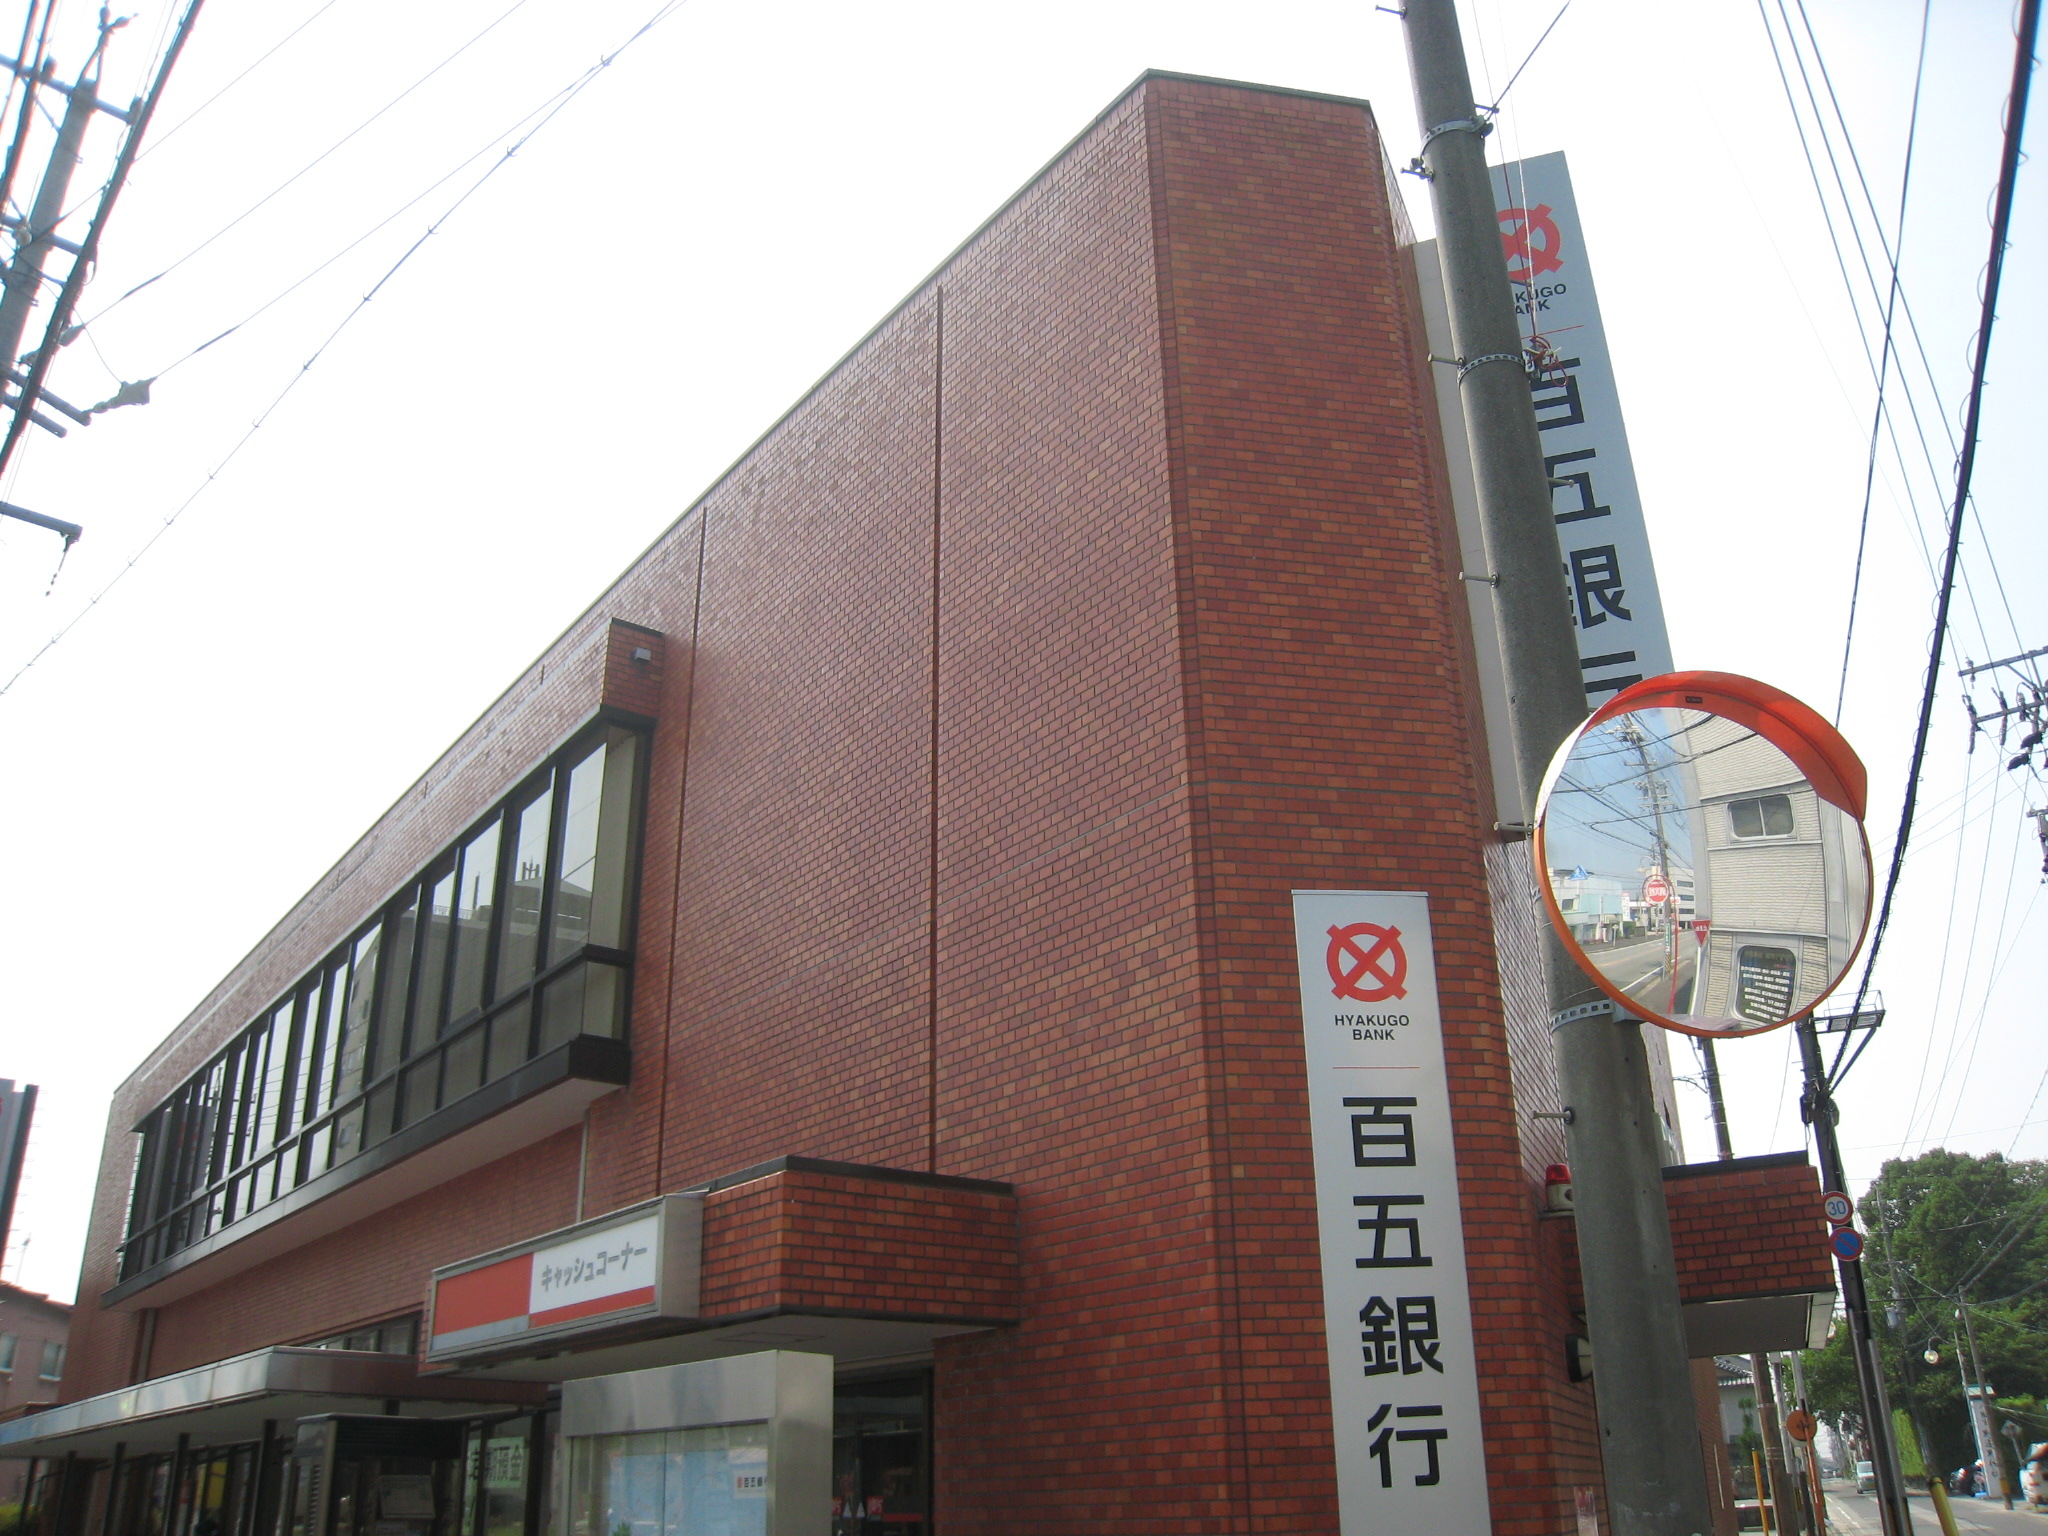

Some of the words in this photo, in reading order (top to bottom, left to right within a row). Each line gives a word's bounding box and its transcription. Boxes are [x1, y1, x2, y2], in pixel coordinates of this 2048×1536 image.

[1515, 283, 1567, 303] KUGO
[1515, 299, 1551, 315] ANK
[1333, 1014, 1410, 1027] HYAKUGO
[1351, 1029, 1396, 1042] BANK
[1826, 1200, 1848, 1216] 30
[541, 1241, 648, 1292] キャッシュコーナー
[1342, 1096, 1449, 1489] 百五銀行
